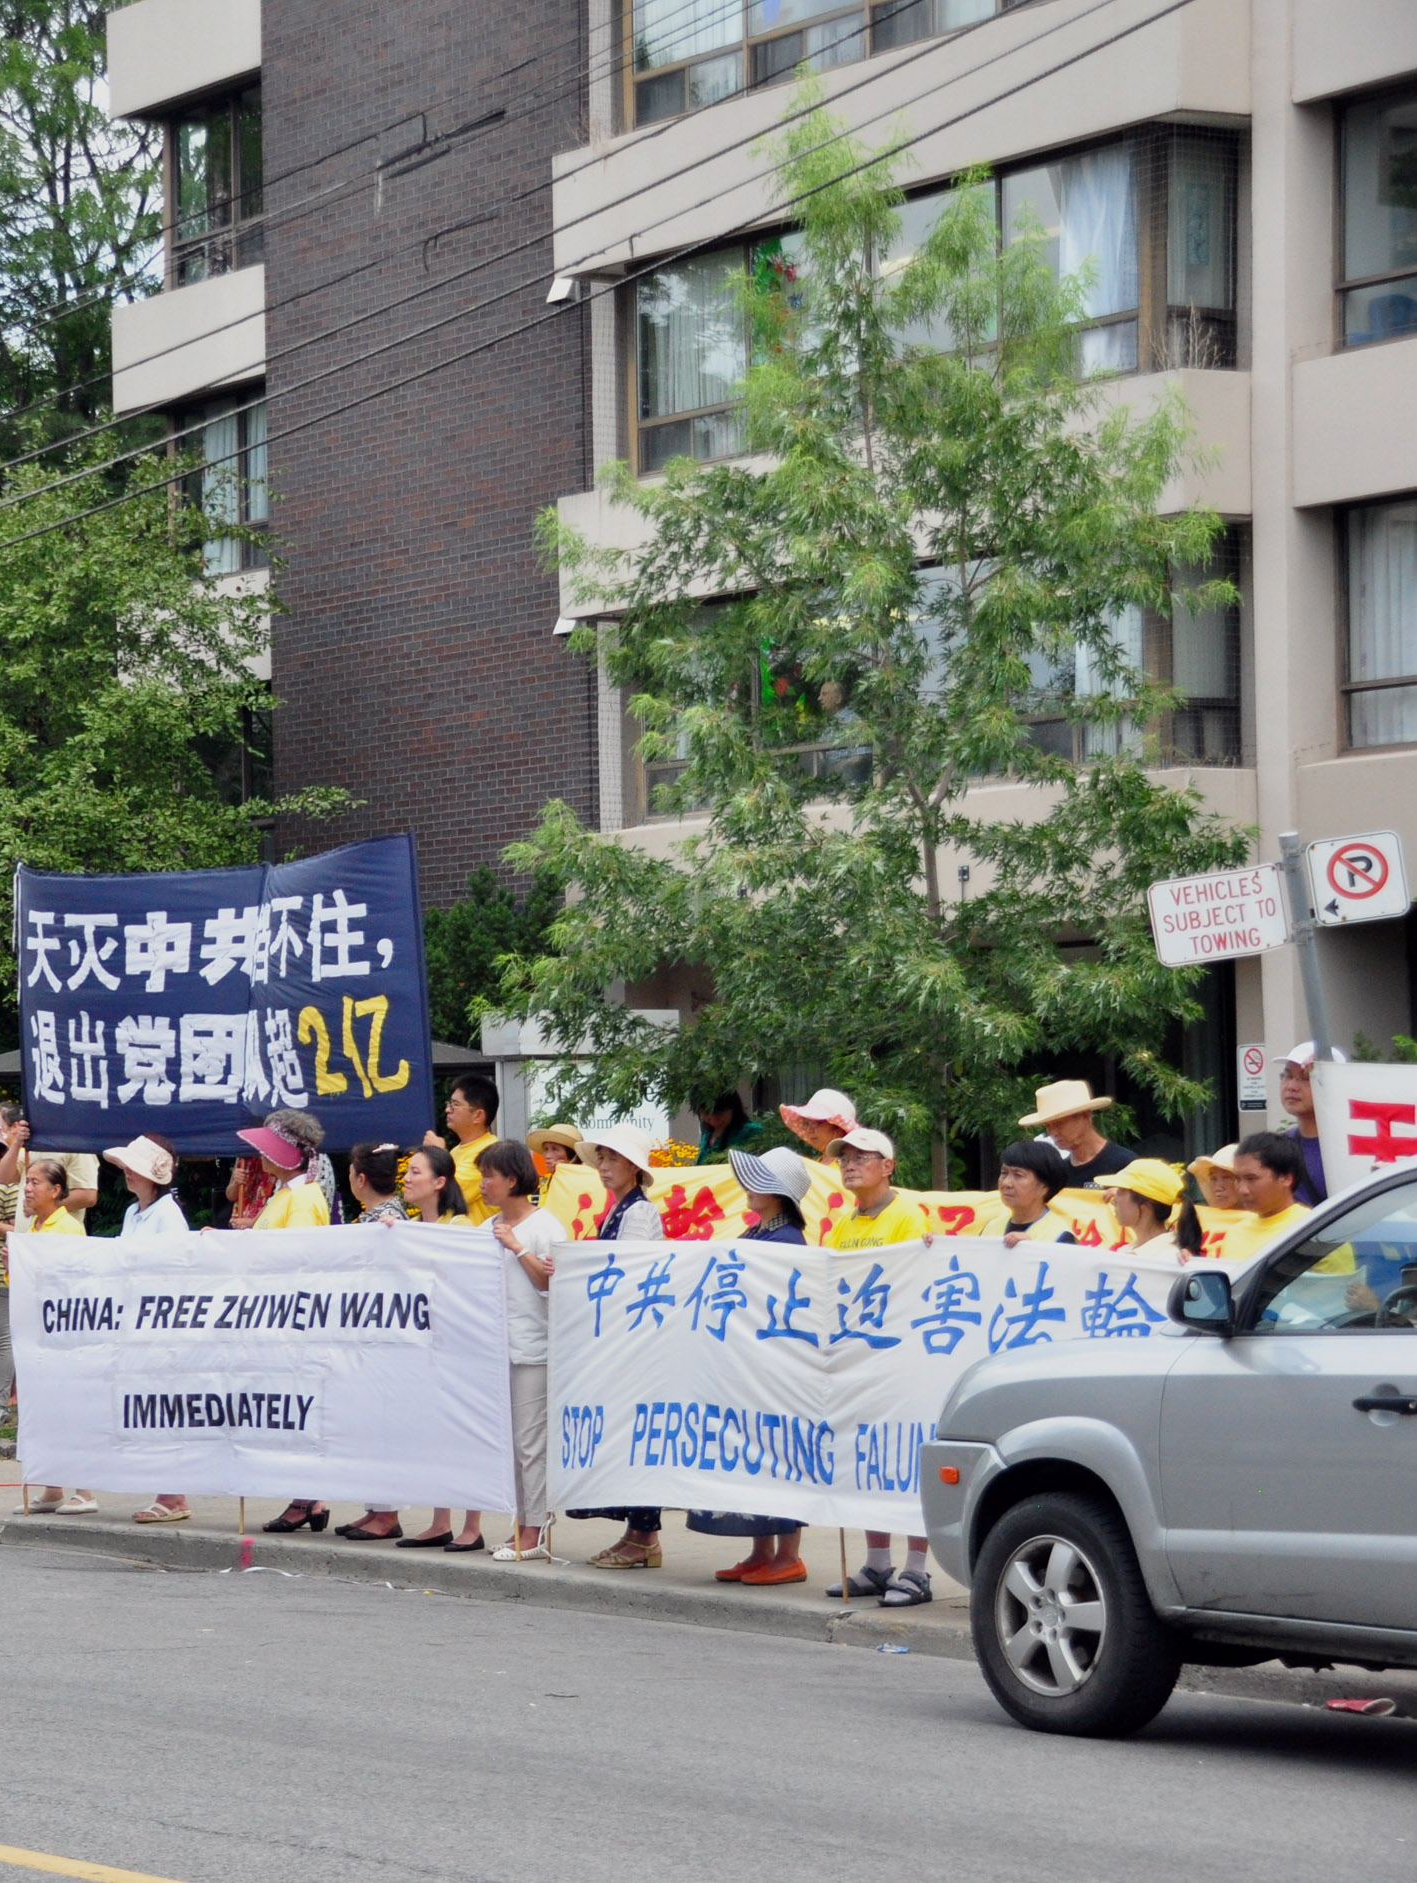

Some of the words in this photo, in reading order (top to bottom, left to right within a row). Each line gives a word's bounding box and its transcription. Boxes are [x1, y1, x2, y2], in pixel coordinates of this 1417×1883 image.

[1169, 876, 1263, 906] VEHICLES
[1162, 903, 1245, 933] SUBJECT
[1255, 897, 1276, 919] TO
[1189, 927, 1261, 955] TOWING
[42, 1295, 124, 1334] CHINA:
[135, 1294, 214, 1330] FREE
[213, 1290, 332, 1331] ZHIWEN
[339, 1292, 431, 1331] WANG
[123, 1393, 314, 1431] IMMEDIATELY
[562, 1405, 604, 1470] STOP
[629, 1402, 835, 1486] PERSECUTING
